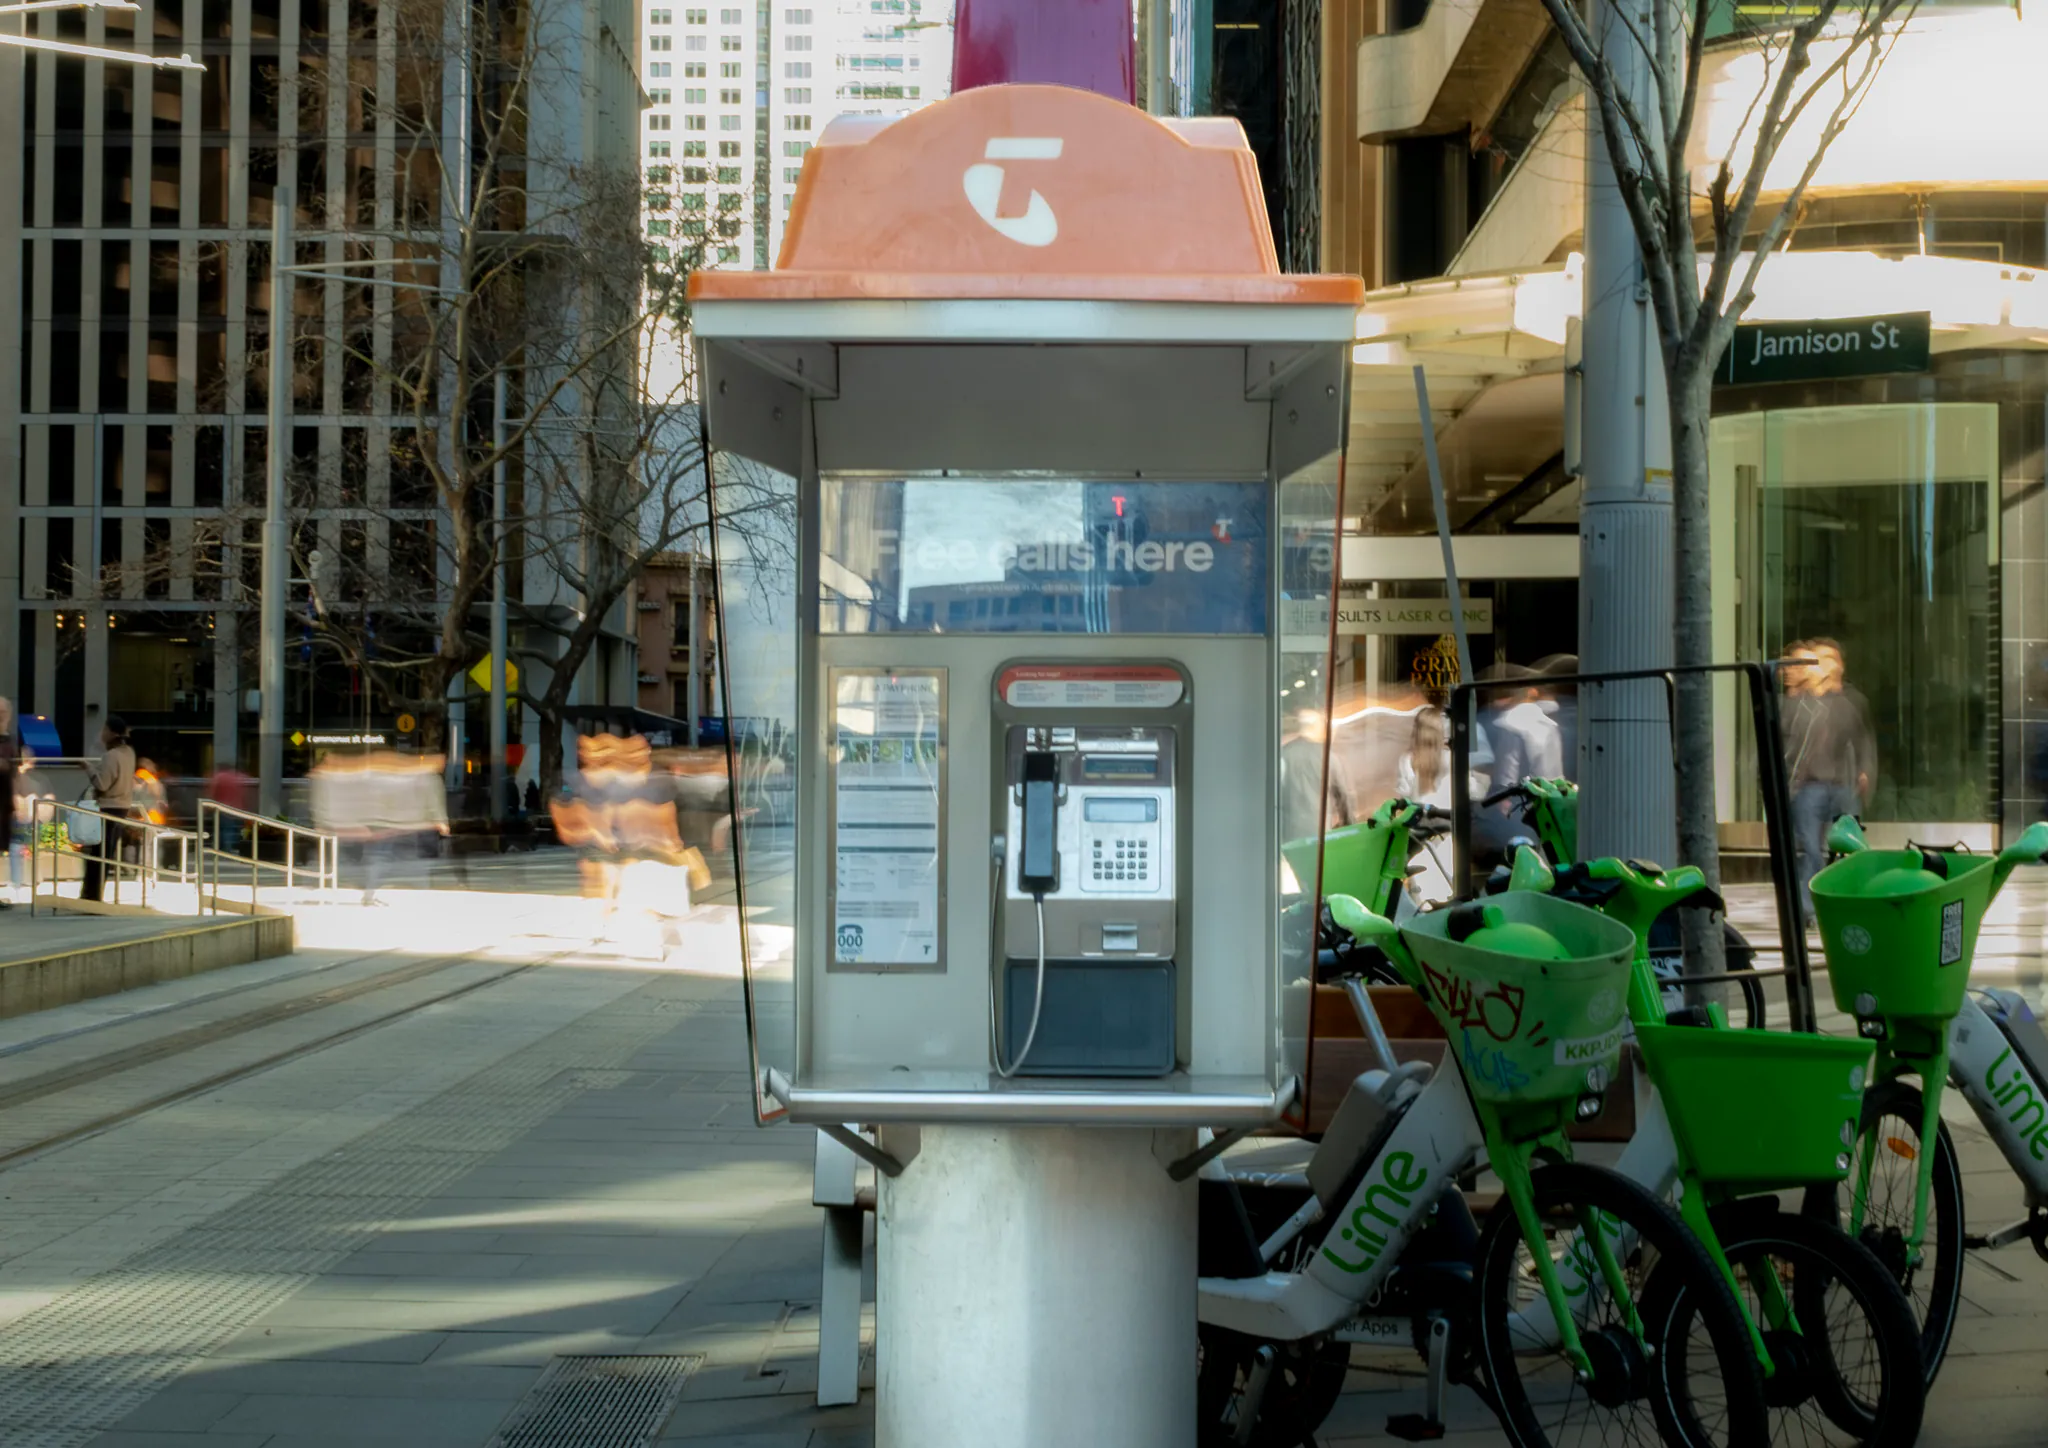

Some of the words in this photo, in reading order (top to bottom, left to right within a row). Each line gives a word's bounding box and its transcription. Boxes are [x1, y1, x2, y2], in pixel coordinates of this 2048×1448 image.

[1751, 328, 1860, 365] Jamison
[1870, 321, 1900, 350] St
[871, 529, 978, 572] Fee
[989, 529, 1096, 572] calls
[1106, 529, 1214, 572] here
[1320, 610, 1382, 623] RSULTS
[1387, 610, 1433, 623] LASER
[1438, 610, 1489, 623] CNIC
[837, 934, 864, 948] 000
[1984, 1046, 2048, 1161] Lime
[1322, 1150, 1428, 1274] Lime
[1361, 1320, 1399, 1338] Apps
